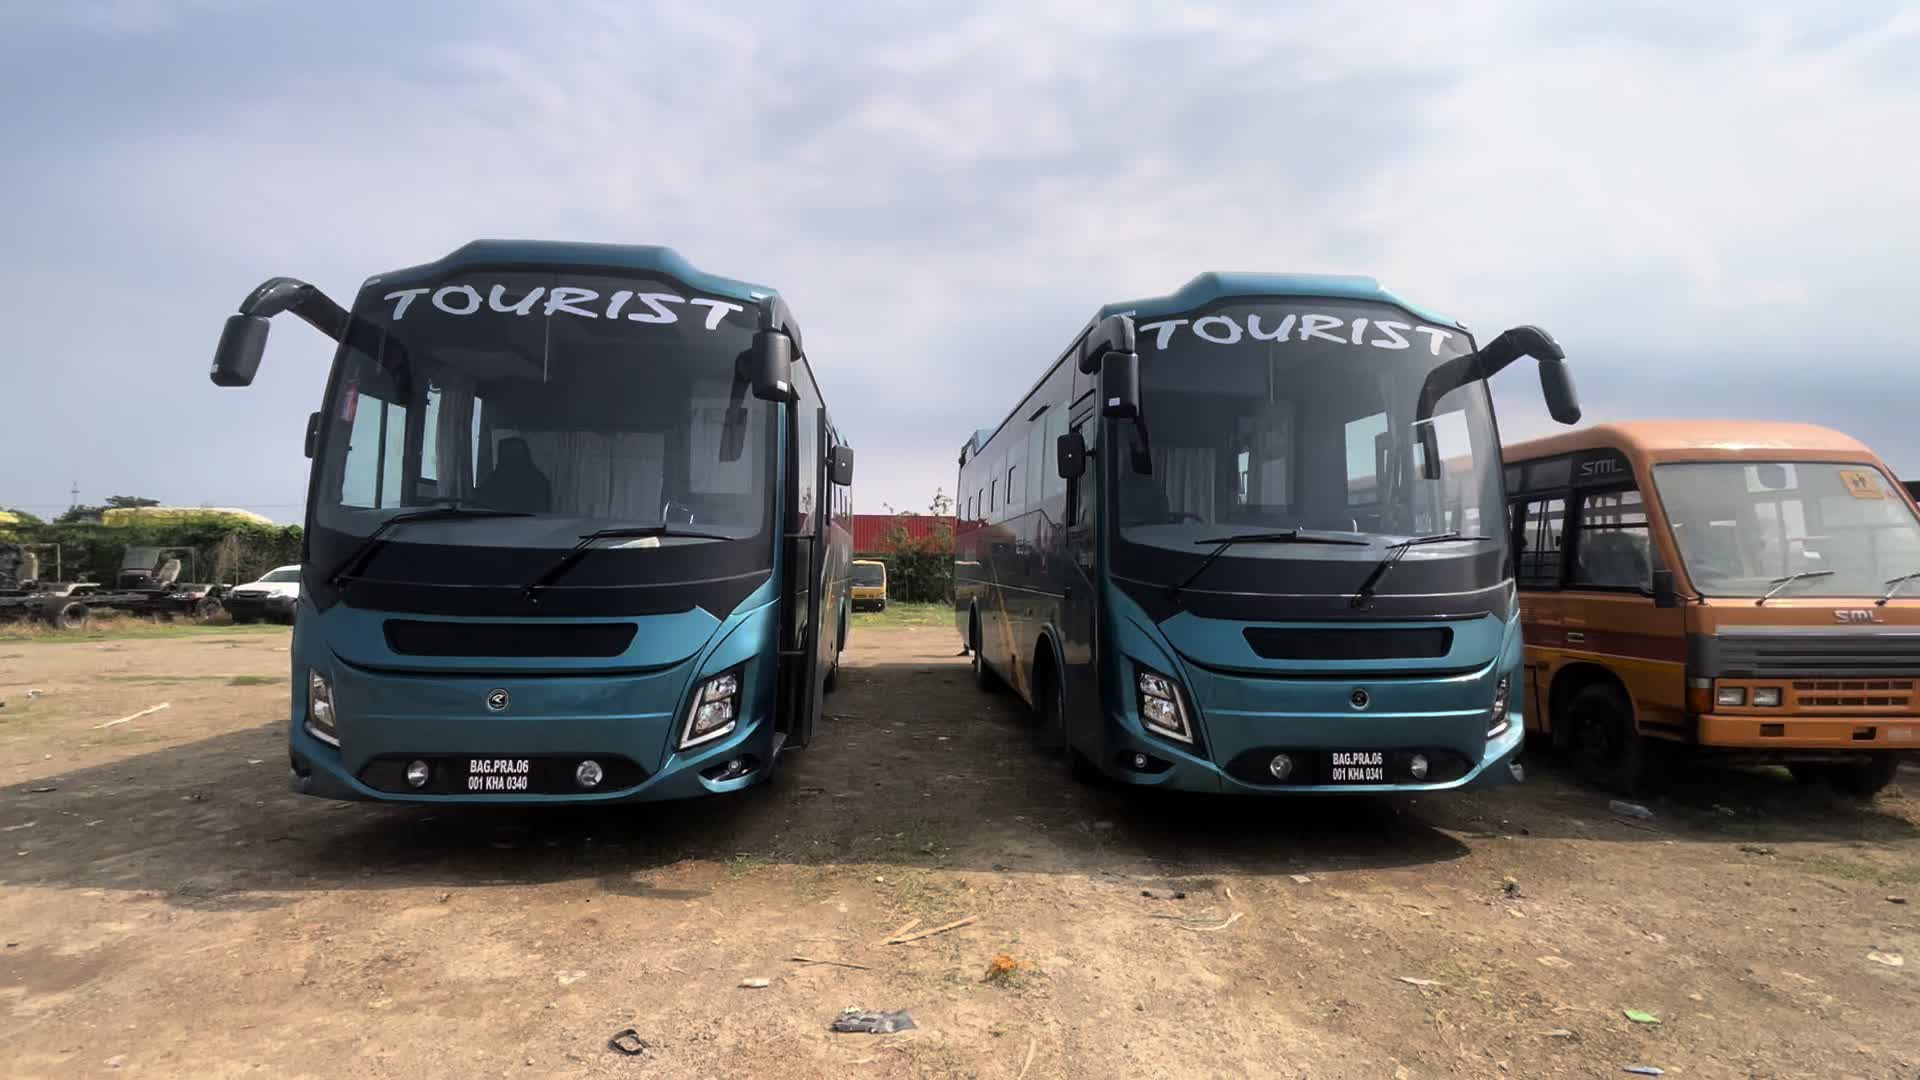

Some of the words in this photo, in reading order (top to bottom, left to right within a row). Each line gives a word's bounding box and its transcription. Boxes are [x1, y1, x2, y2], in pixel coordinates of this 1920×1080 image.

[384, 284, 744, 331] TOURIST
[1139, 314, 1454, 356] TOURIST
[1580, 459, 1625, 476] SML
[1833, 610, 1885, 624] SML
[470, 759, 529, 774] BAG.PRA.06
[1332, 752, 1383, 766] BAG.PRA.06
[1332, 767, 1346, 781] 001
[1348, 767, 1365, 781] KHA
[1366, 767, 1383, 781] 0341
[468, 776, 483, 791] 001
[486, 776, 505, 791] KHA
[506, 776, 528, 791] 0340
